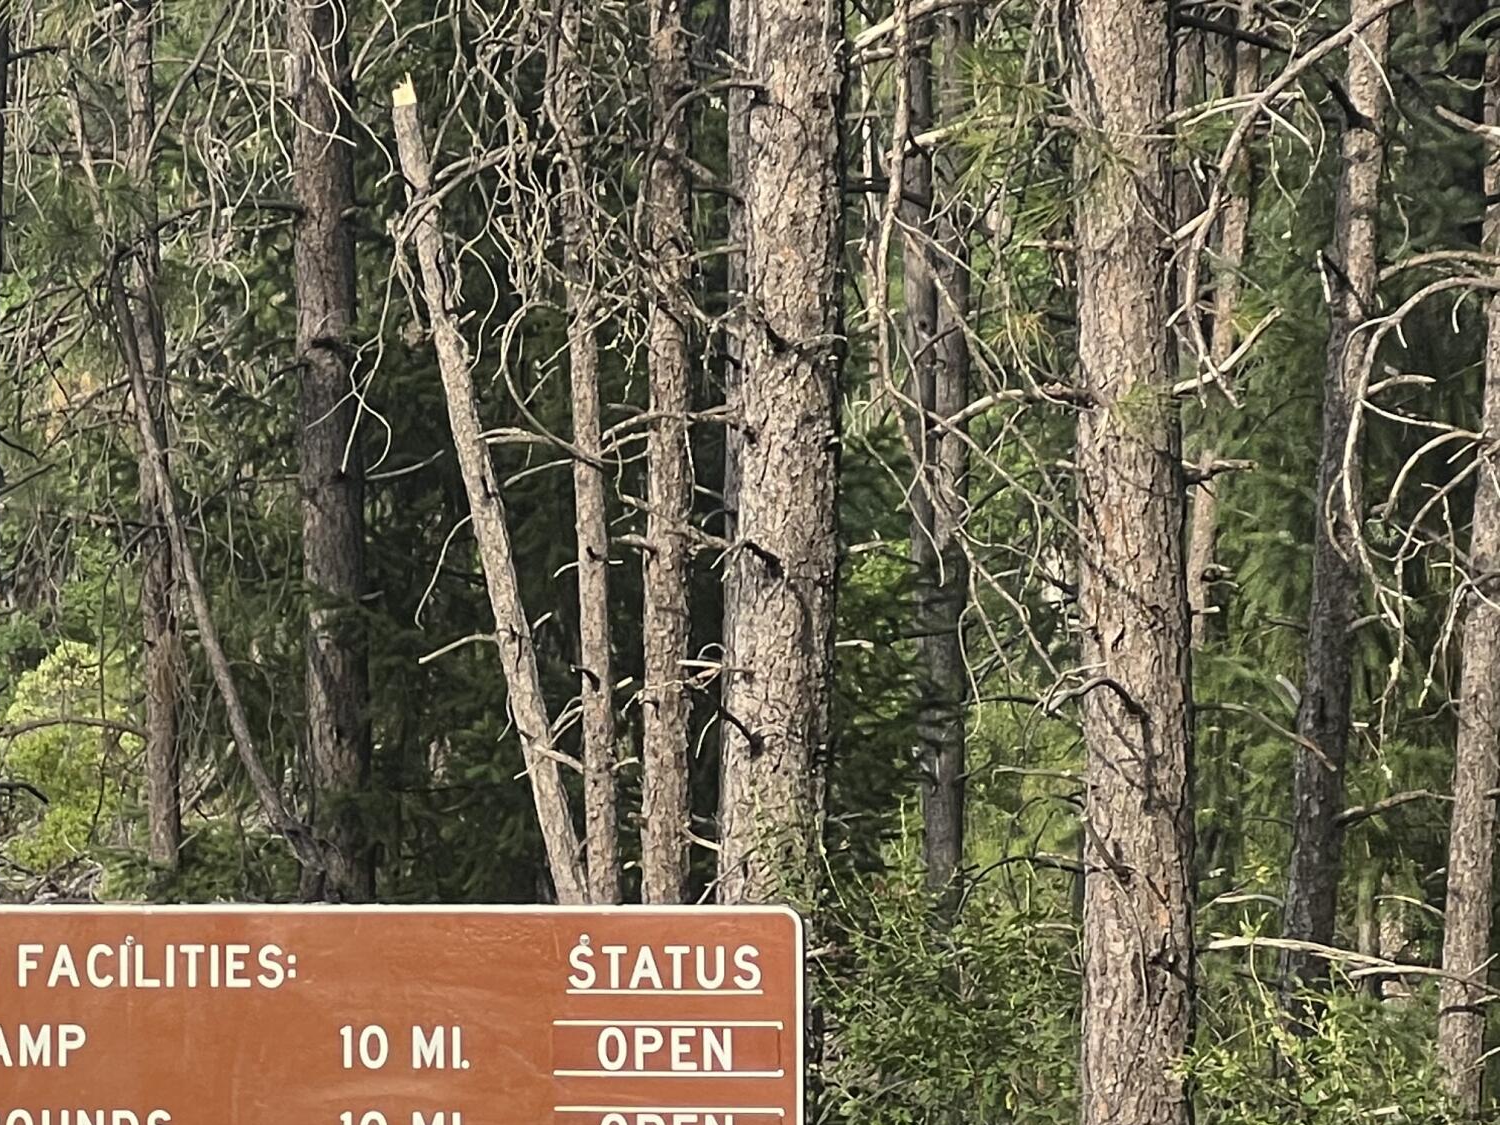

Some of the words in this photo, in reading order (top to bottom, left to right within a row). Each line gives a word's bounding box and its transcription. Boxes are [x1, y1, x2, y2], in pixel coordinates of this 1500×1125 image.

[18, 943, 296, 988] FACILITIES:
[568, 944, 761, 989] STATUS
[340, 1025, 388, 1069] 10
[412, 1025, 469, 1069] MI.
[598, 1028, 732, 1070] OPEN
